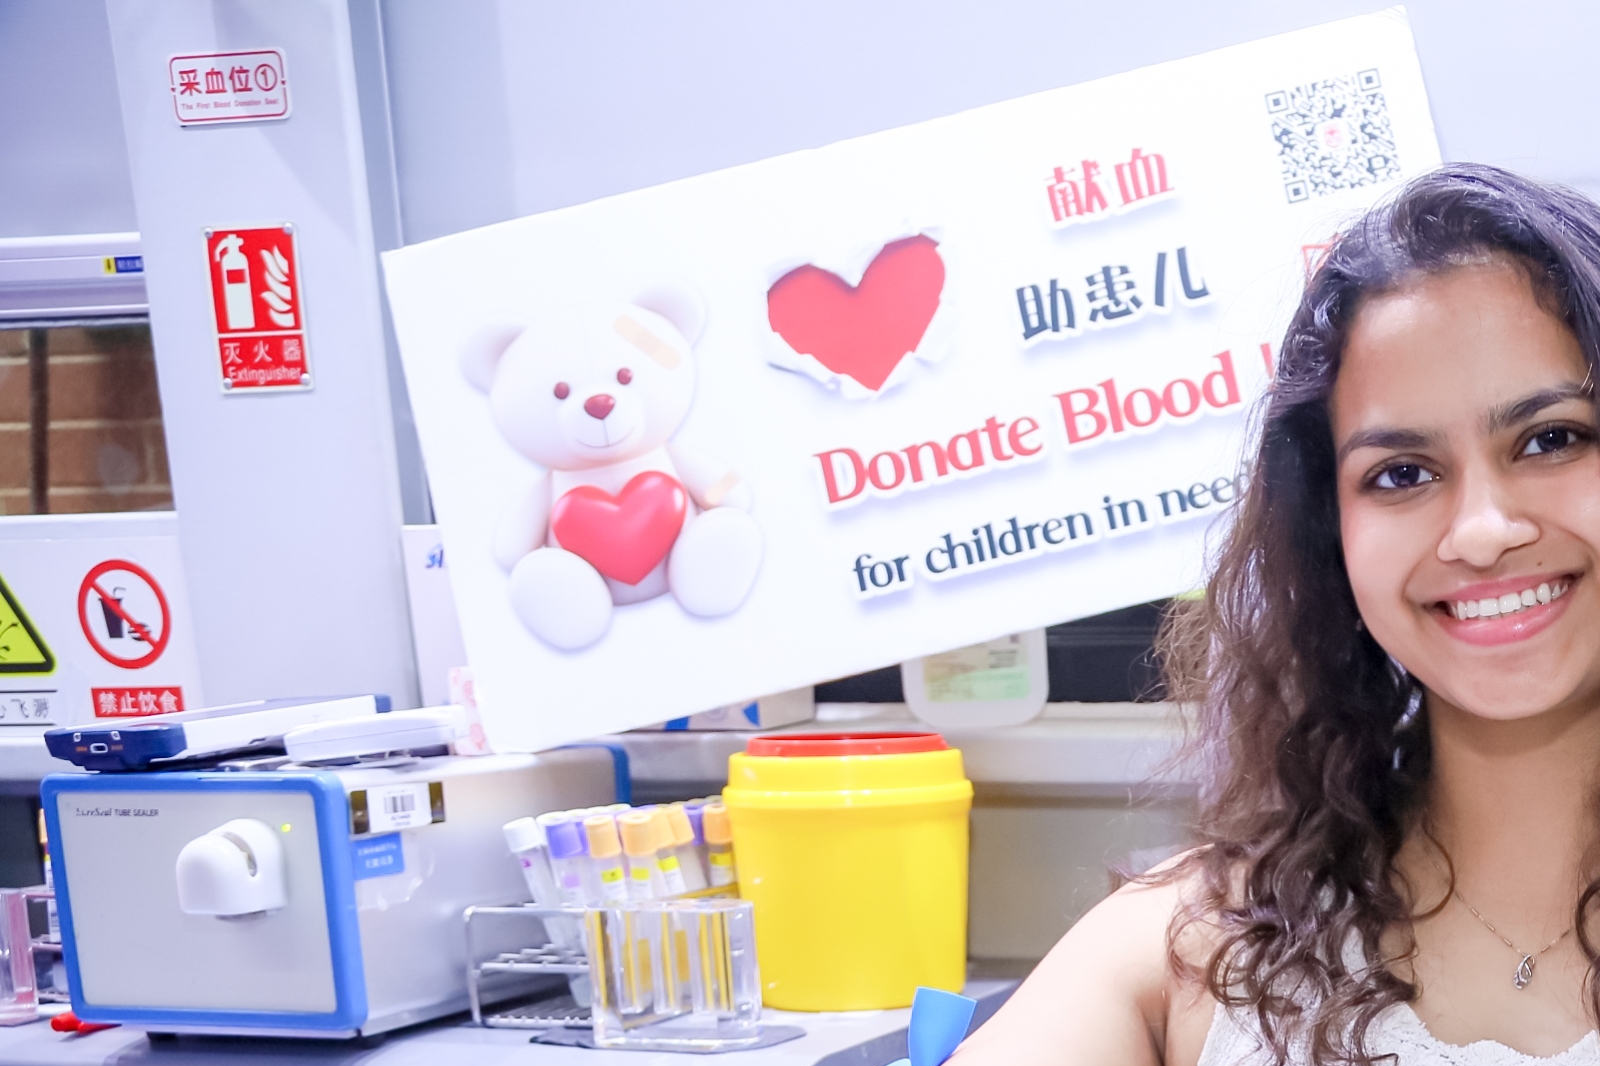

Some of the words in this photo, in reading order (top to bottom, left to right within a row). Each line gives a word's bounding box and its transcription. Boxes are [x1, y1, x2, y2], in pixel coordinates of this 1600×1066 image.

[1045, 147, 1176, 222] 献血
[1015, 245, 1210, 340] 助患儿
[223, 339, 302, 364] 灭火器
[228, 365, 301, 385] Extinguisher
[813, 415, 1043, 504] Donate
[1055, 348, 1241, 445] Blood
[853, 555, 909, 593] for
[926, 517, 1095, 575] children
[1103, 495, 1147, 532] in
[100, 690, 178, 714] 禁止饮食
